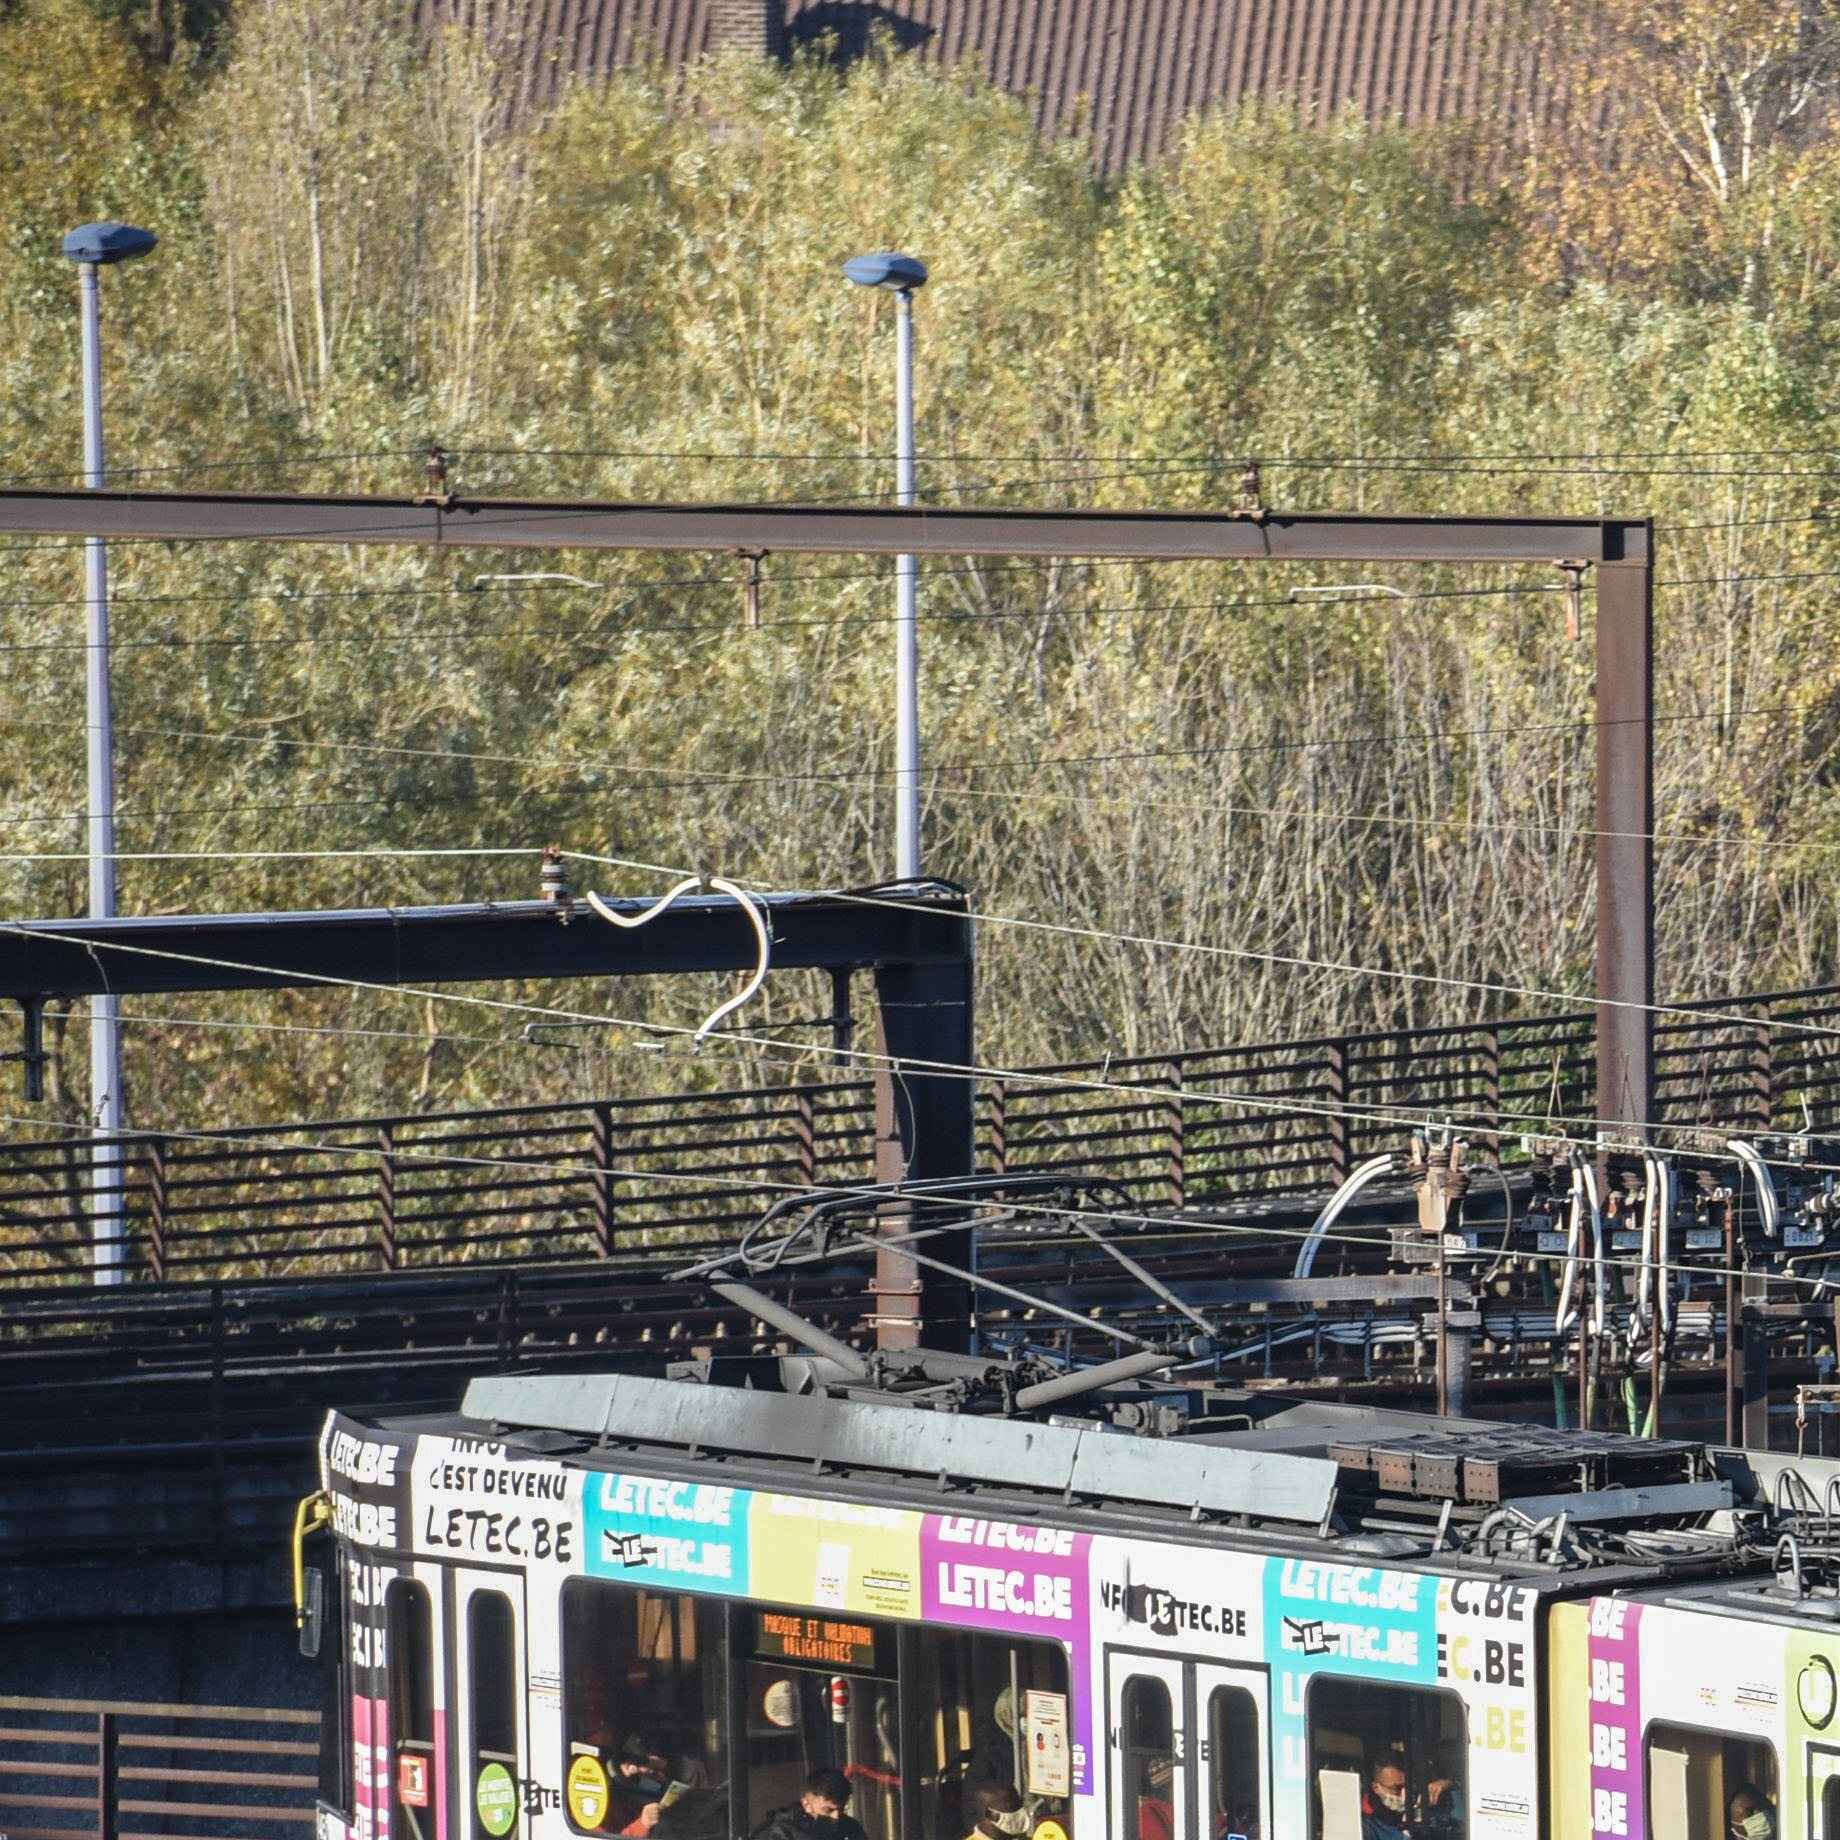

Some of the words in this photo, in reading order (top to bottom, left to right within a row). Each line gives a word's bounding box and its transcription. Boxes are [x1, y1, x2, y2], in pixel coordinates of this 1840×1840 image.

[484, 1468, 567, 1500] DEVENU
[601, 1472, 737, 1526] LETEC.BE
[426, 1505, 573, 1562] LETEC.BE
[939, 1561, 1073, 1620] LETEC.BE
[1280, 1557, 1421, 1613] LETEC.BE
